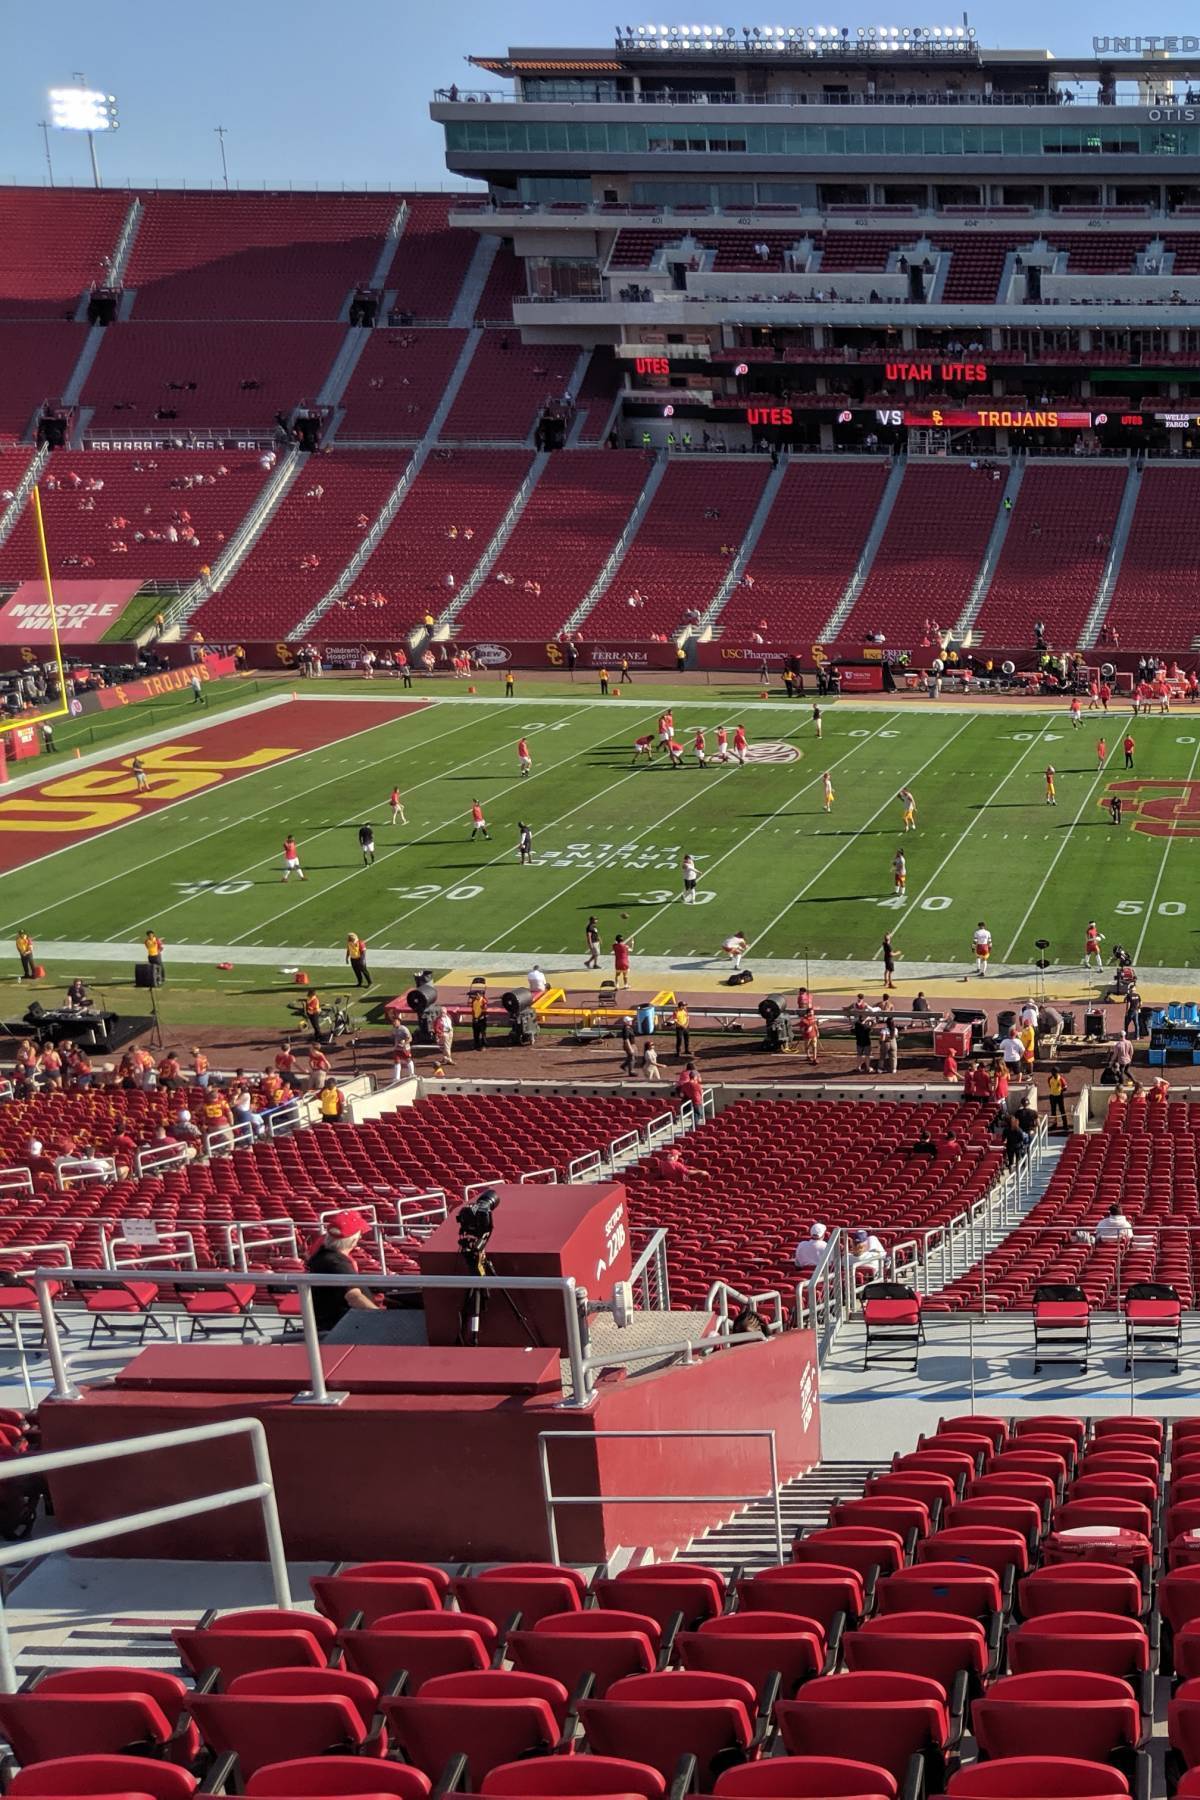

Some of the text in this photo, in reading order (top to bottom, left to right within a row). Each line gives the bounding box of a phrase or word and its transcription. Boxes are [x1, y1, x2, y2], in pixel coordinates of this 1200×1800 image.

[1092, 36, 1197, 53] UNITED
[1148, 109, 1195, 122] OTIS
[635, 358, 670, 375] UTES
[885, 363, 987, 381] UTAH UTES
[747, 408, 793, 425] UTES
[878, 410, 902, 425] VS
[978, 411, 1058, 427] TROJANS
[1121, 415, 1143, 425] UTES
[1165, 421, 1190, 429] FARGO
[8, 604, 118, 617] MUSCLE
[17, 617, 88, 630] MILK
[326, 653, 360, 662] Hospital
[721, 649, 744, 660] USC
[400, 884, 485, 900] 20
[637, 889, 719, 906] 30
[876, 895, 954, 912] 40
[1113, 900, 1187, 916] 50
